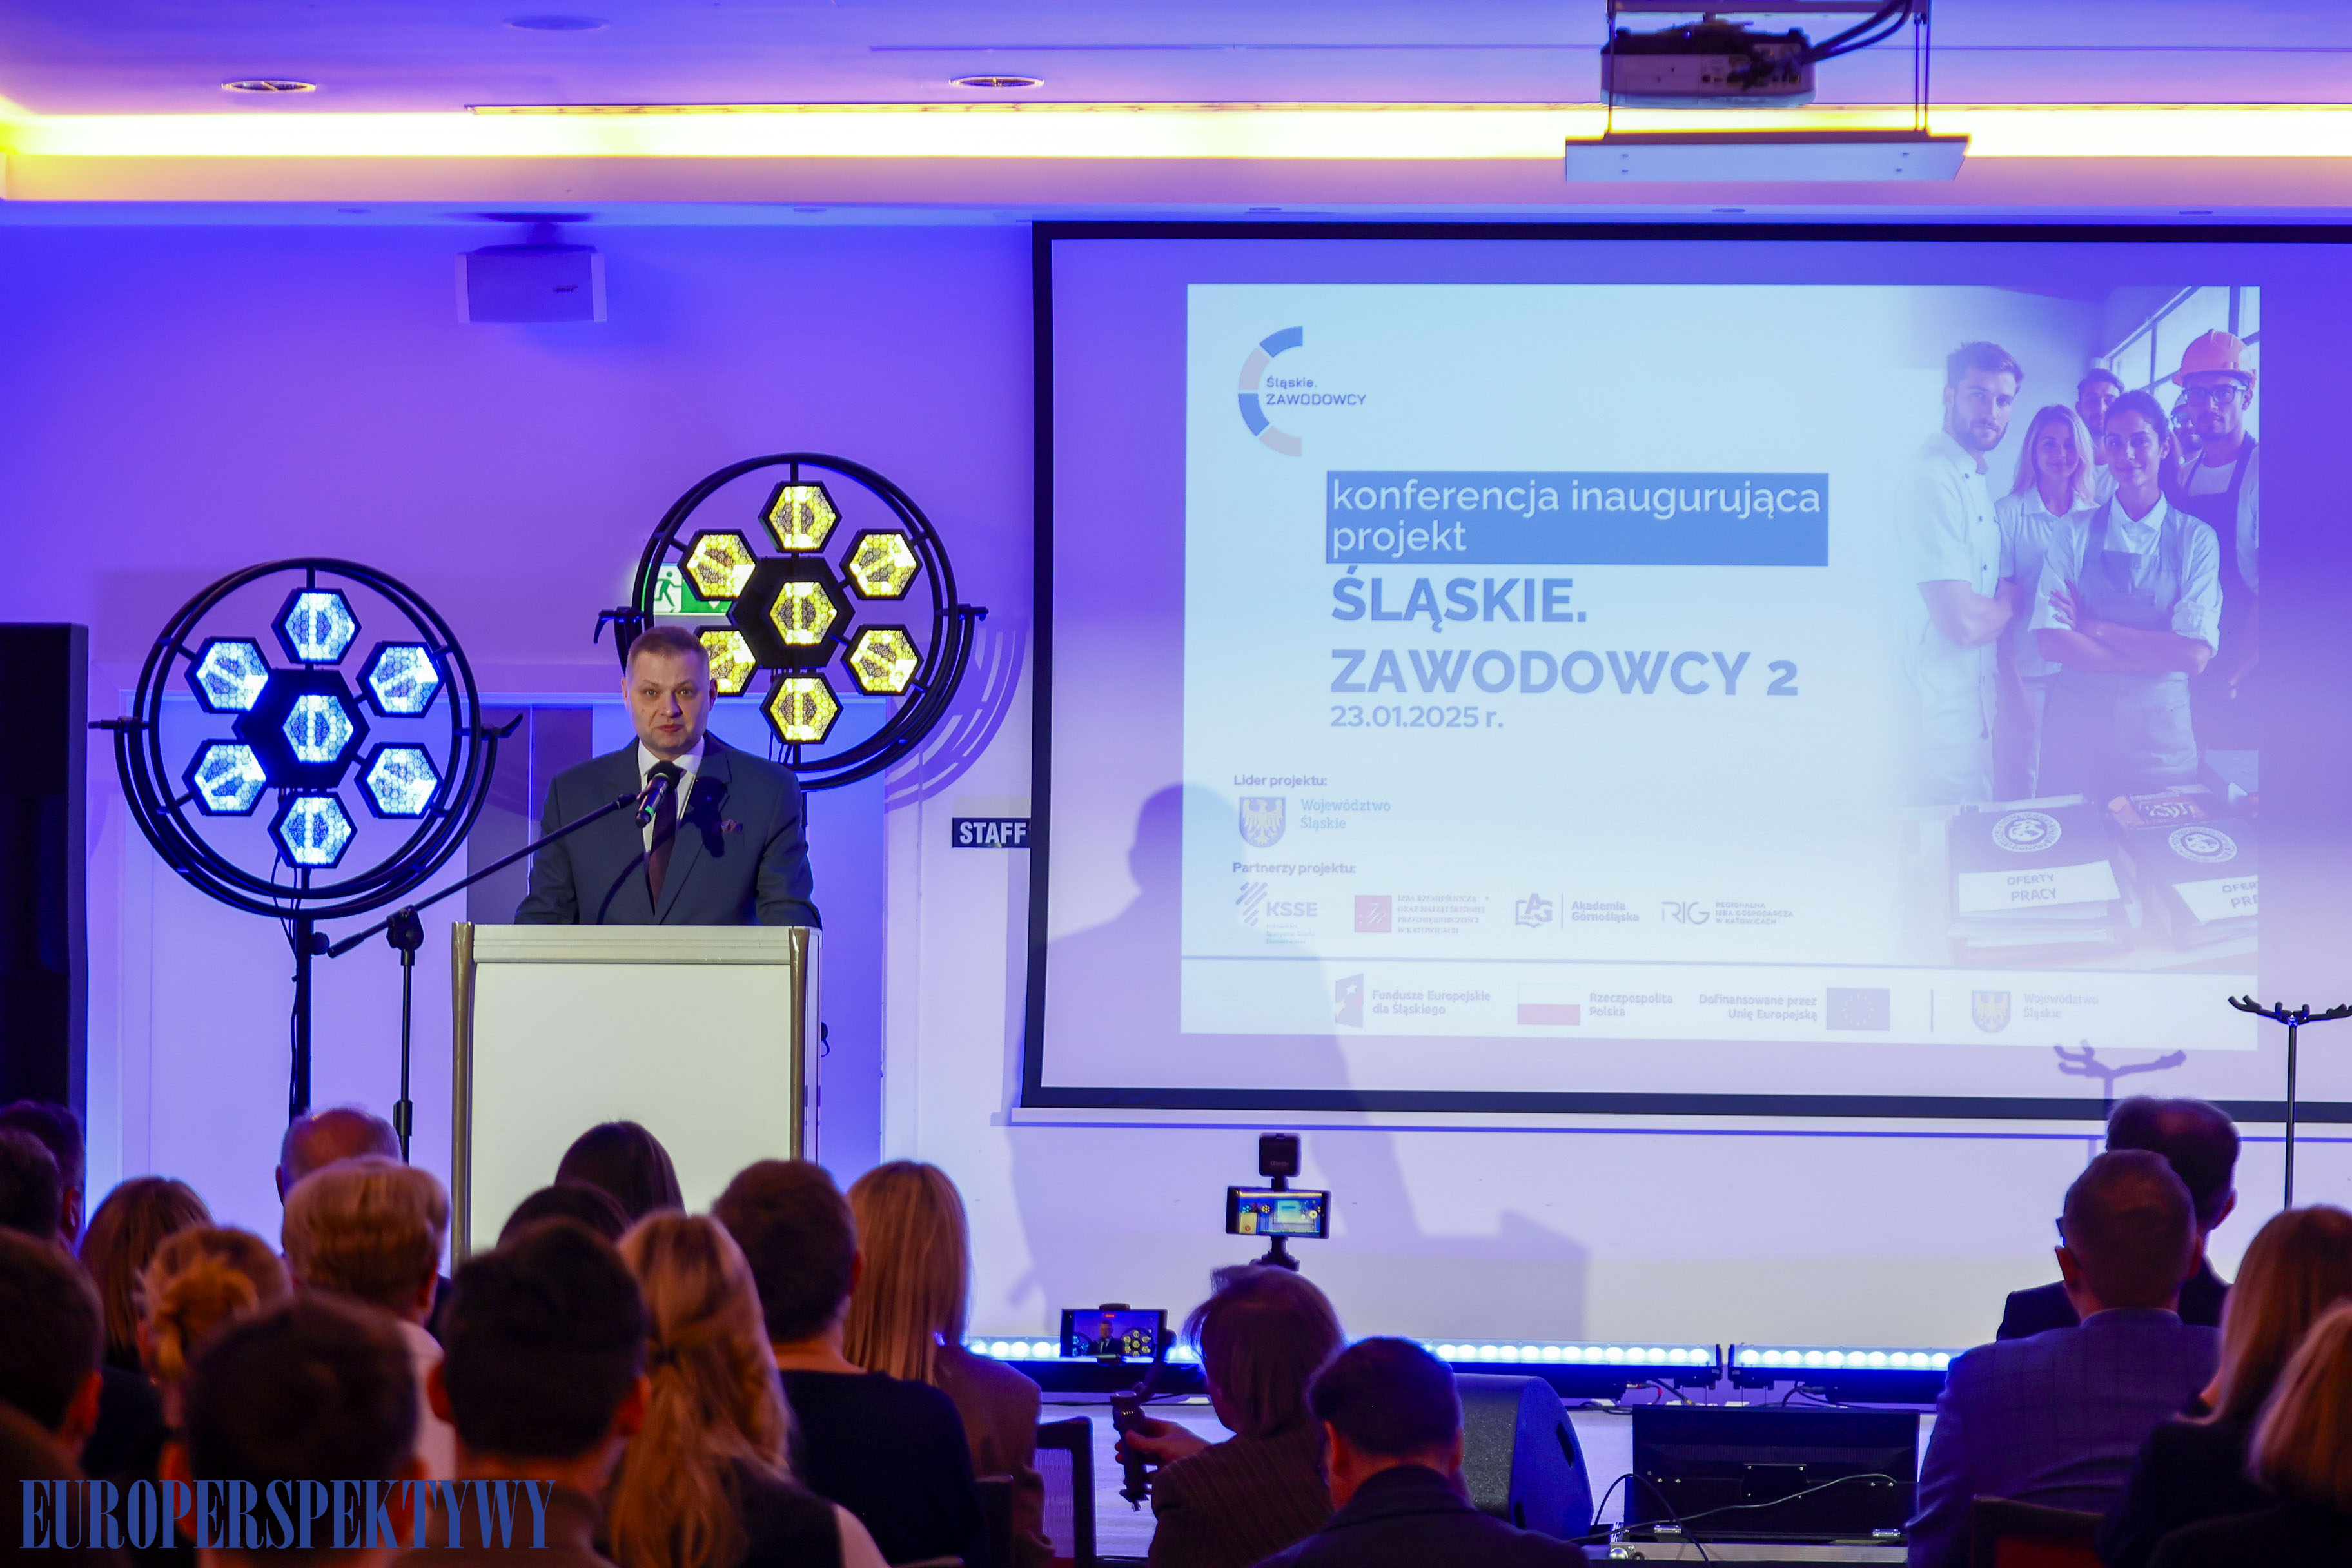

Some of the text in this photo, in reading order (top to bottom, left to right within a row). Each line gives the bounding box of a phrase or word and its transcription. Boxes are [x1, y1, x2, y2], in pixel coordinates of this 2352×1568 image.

[1266, 376, 1317, 389] Śląskie.
[1266, 393, 1366, 405] ZAWODOWCY
[1333, 479, 1820, 519] konferencja inaugurująca
[1333, 520, 1467, 558] projekt
[1331, 565, 1587, 633] ŚLĄSKIE.
[1331, 649, 1798, 696] ZAWODOWCY 2
[1331, 705, 1504, 727] 23.01.2025 r.
[1233, 775, 1328, 788] Lider projektu:
[1301, 798, 1391, 812] Województwo
[1300, 816, 1346, 830] Śląskie
[960, 821, 1026, 844] STAFF
[1233, 862, 1356, 876] Partnerzy projektu:
[2007, 874, 2055, 885] OFERTY
[2011, 888, 2057, 902] PRACY
[1266, 901, 1318, 917] KSSE
[1571, 901, 1626, 910] Akademia
[1572, 911, 1640, 923] Górnośląska
[1372, 990, 1491, 1003] Fundusze Europejskie
[1589, 992, 1673, 1006] Rzeczpospolita
[1699, 994, 1818, 1008] Dofinansowane przez
[2023, 993, 2099, 1005] Województwo
[1372, 1002, 1446, 1016] dla Śląskiego
[1589, 1006, 1625, 1017] Polska
[1729, 1008, 1818, 1022] Unię Europejską
[2023, 1006, 2062, 1020] Śląskie
